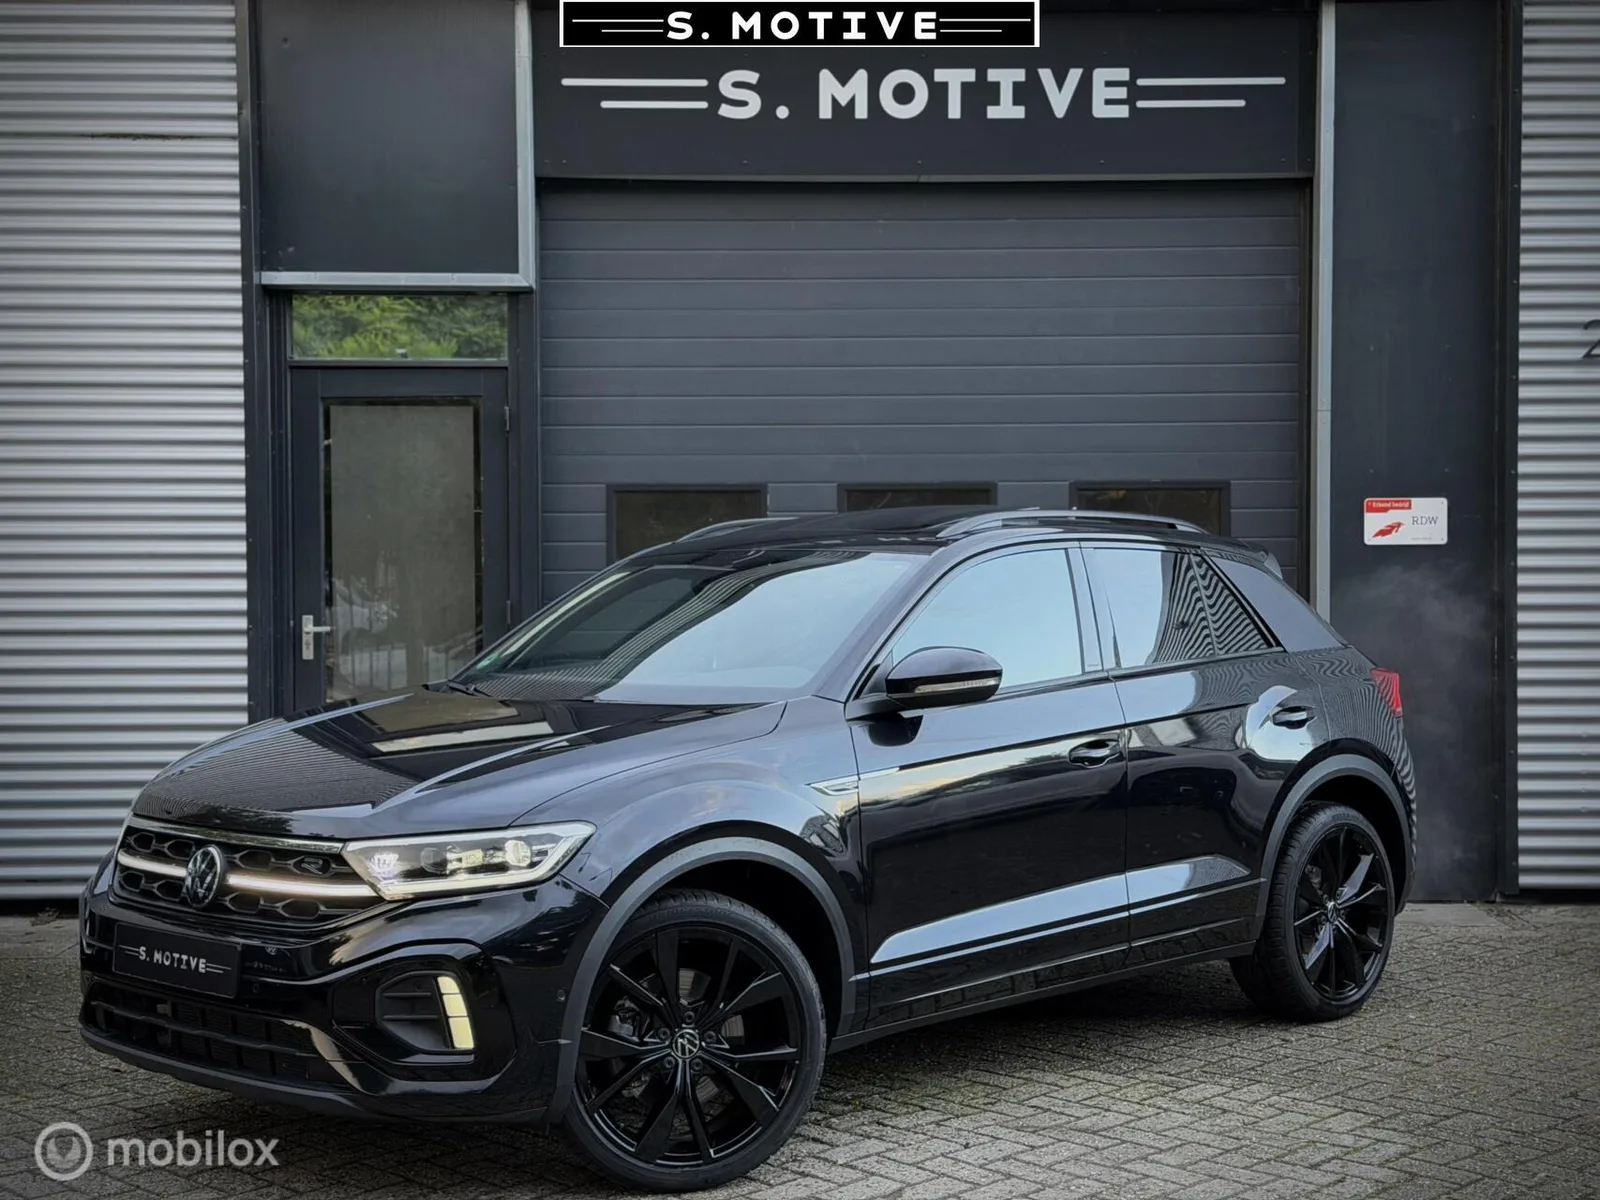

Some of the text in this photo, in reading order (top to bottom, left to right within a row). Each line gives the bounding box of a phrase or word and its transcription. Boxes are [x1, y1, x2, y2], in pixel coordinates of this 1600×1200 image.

[717, 67, 1130, 120] S. MOTIVE
[1411, 515, 1439, 526] RDW
[139, 946, 207, 974] S. MOTIVE
